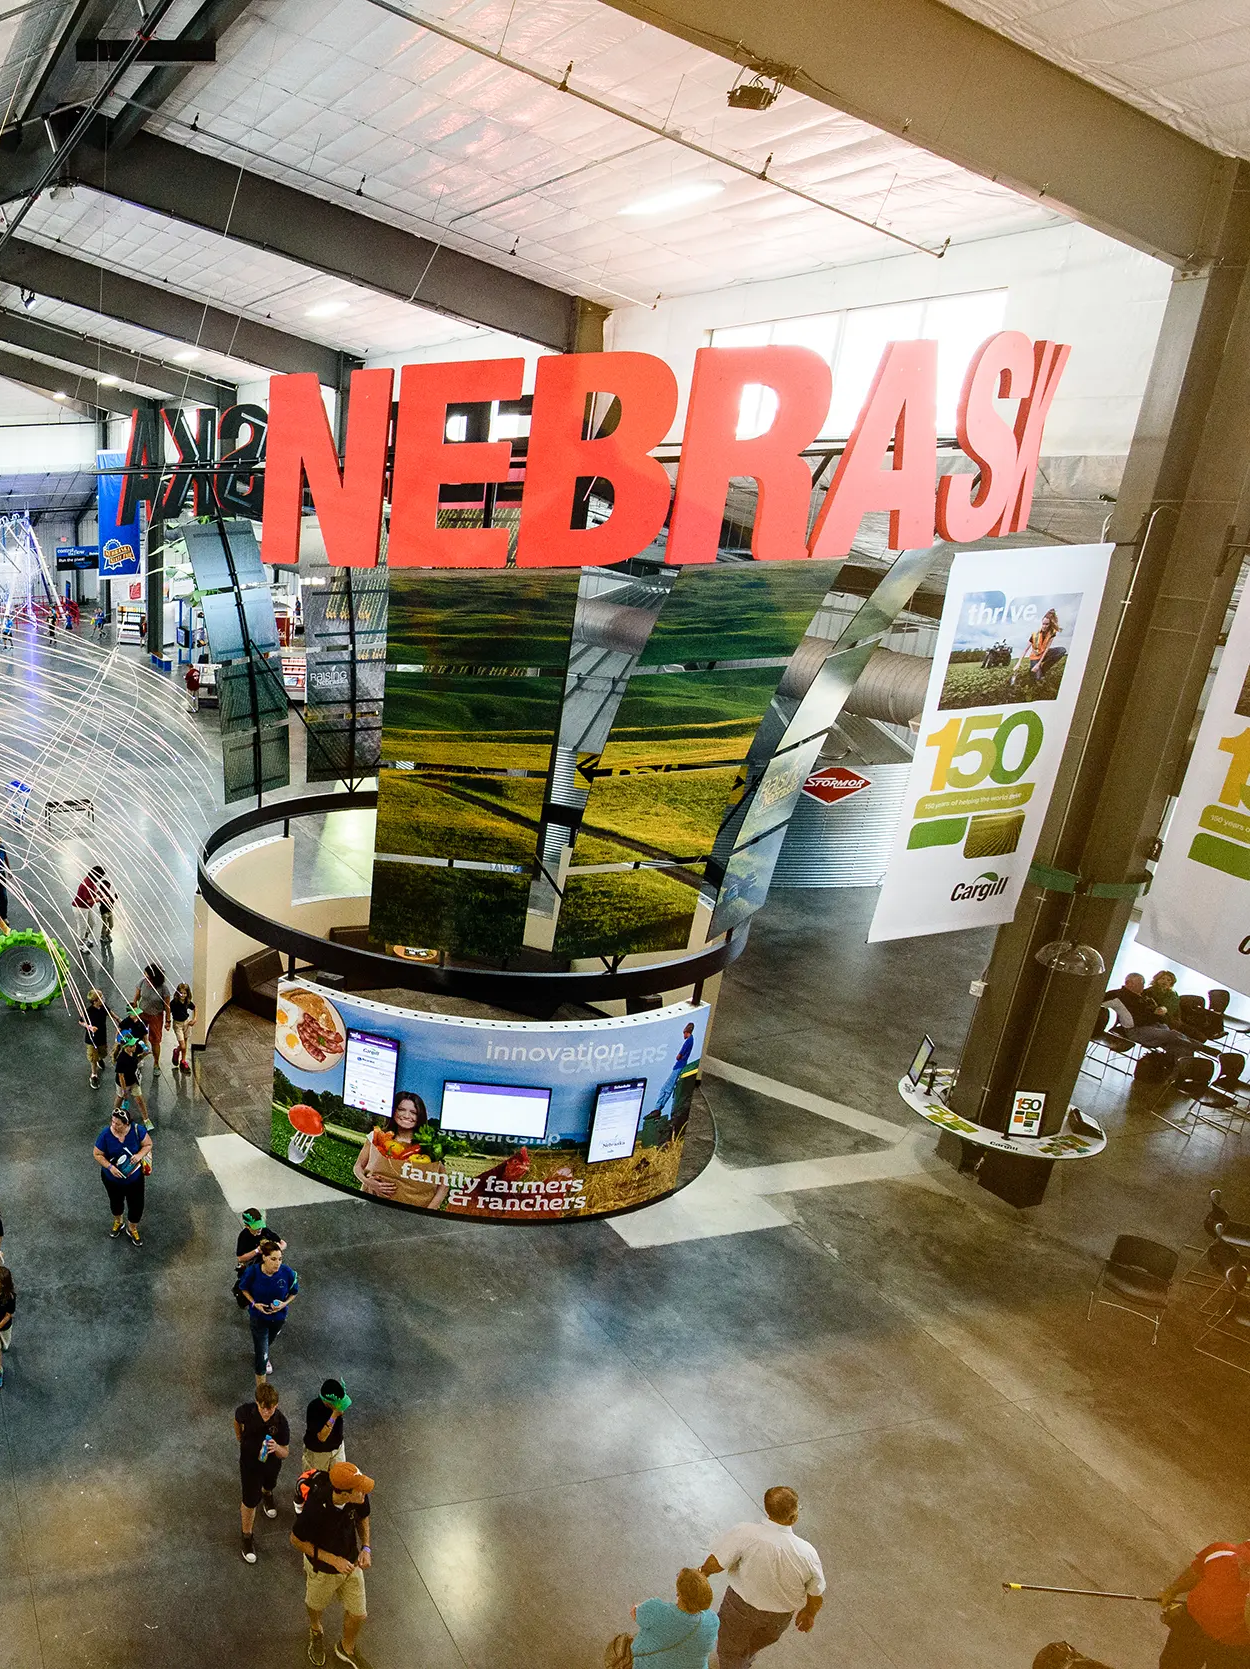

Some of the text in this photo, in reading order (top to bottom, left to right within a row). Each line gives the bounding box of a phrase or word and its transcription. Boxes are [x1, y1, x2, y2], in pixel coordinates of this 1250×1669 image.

[925, 709, 1045, 792] 150
[1222, 818, 1245, 834] years
[951, 876, 1008, 902] Cargill
[485, 1040, 625, 1062] innovation
[558, 1044, 669, 1074] CAREERS
[1016, 1098, 1042, 1111] 150
[990, 1140, 1019, 1151] Cargill
[401, 1163, 585, 1194] family farmers
[476, 1194, 587, 1212] ranchers
